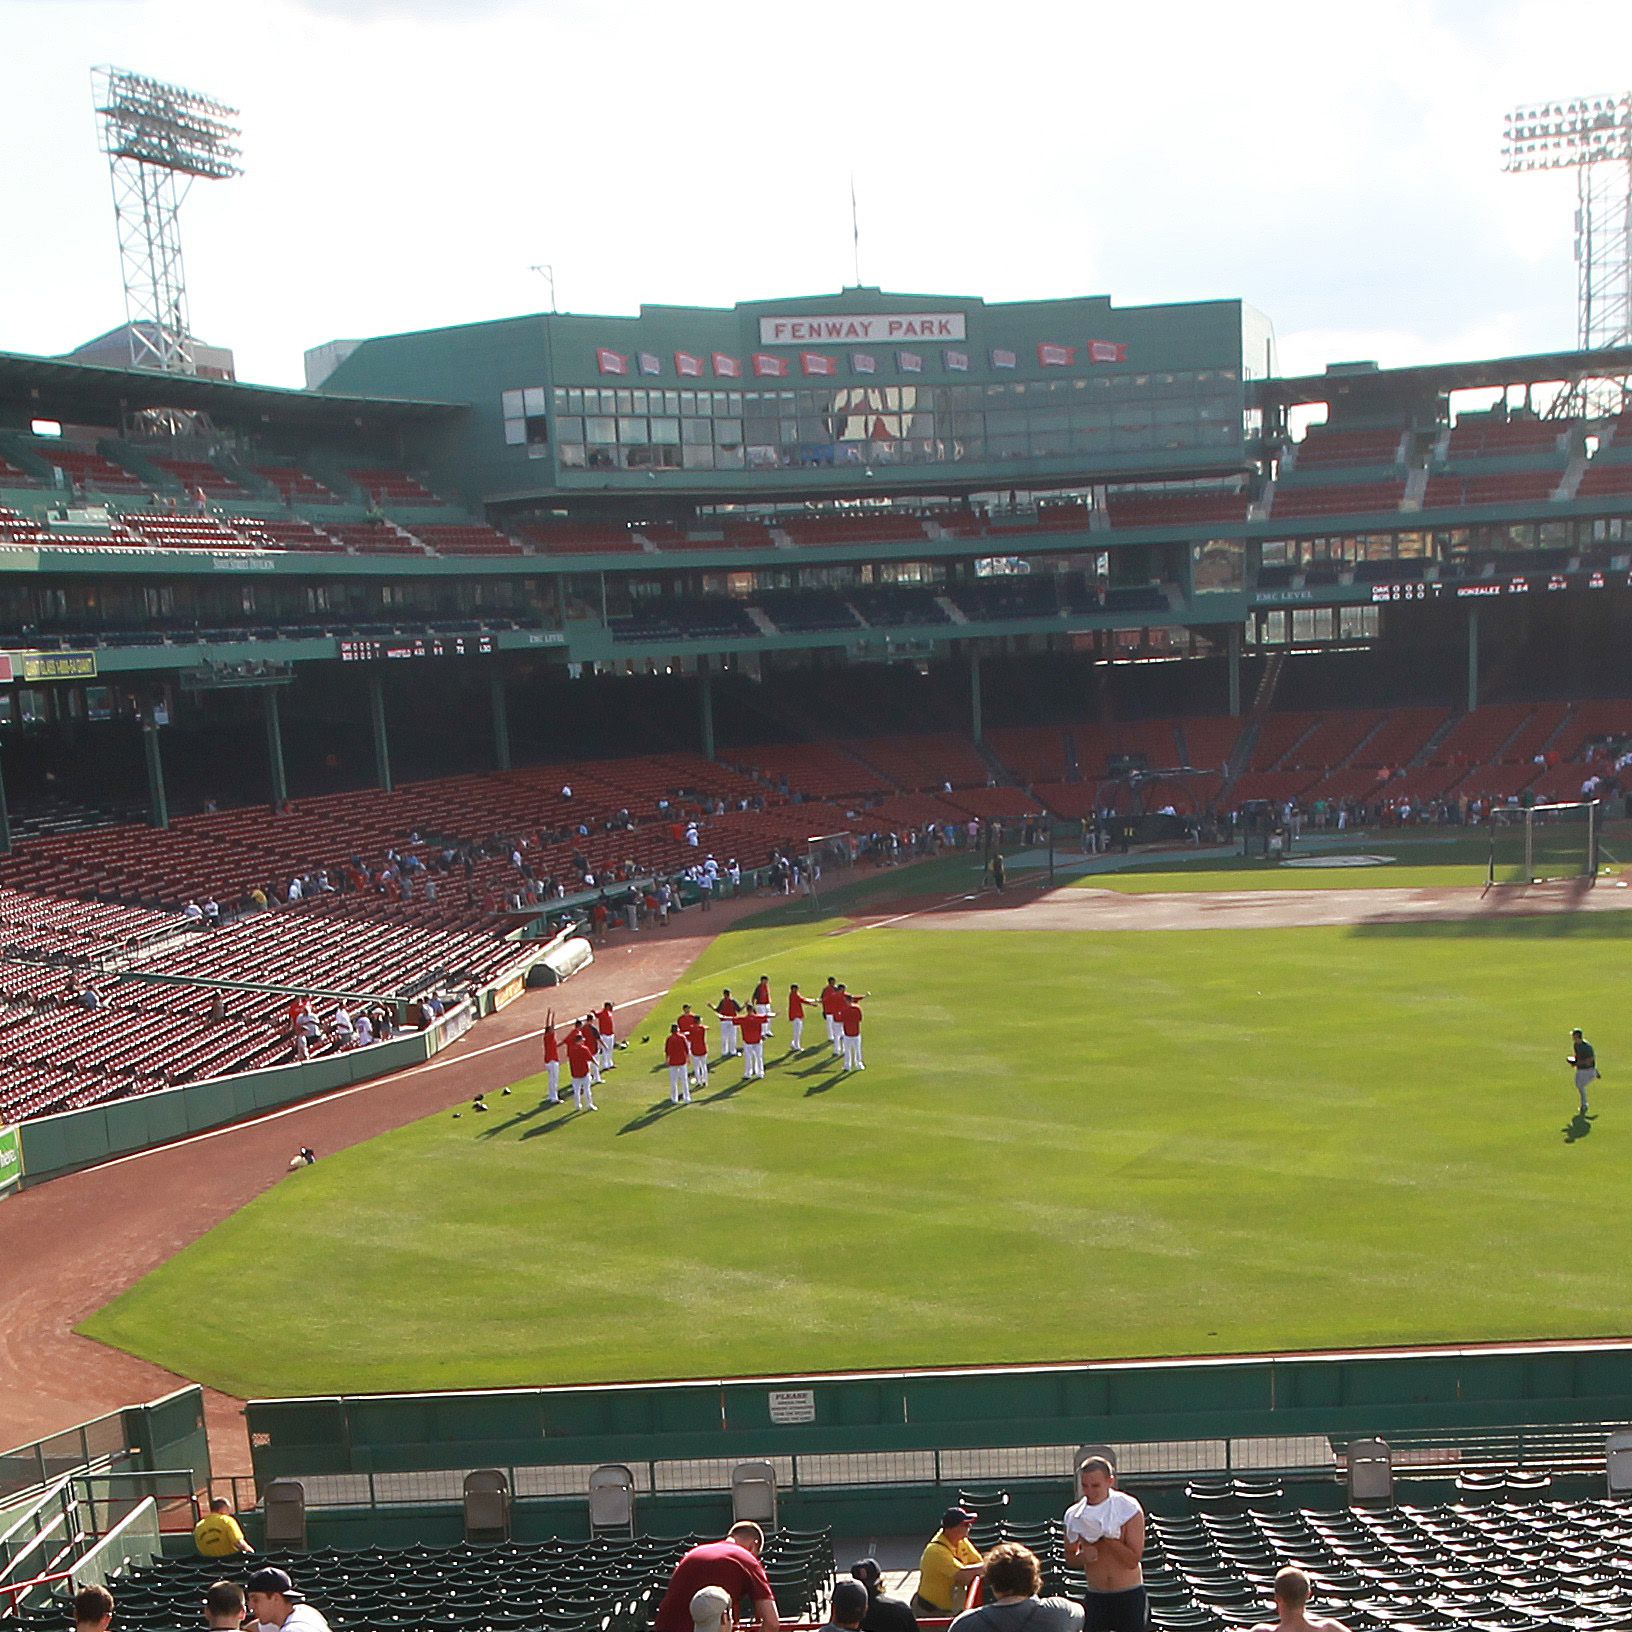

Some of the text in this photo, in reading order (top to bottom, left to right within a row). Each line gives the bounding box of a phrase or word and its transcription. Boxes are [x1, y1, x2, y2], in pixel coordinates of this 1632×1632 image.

[774, 318, 952, 339] FENWAY PARK
[1281, 590, 1313, 600] LEVEL
[1457, 586, 1501, 597] GONZALEZ
